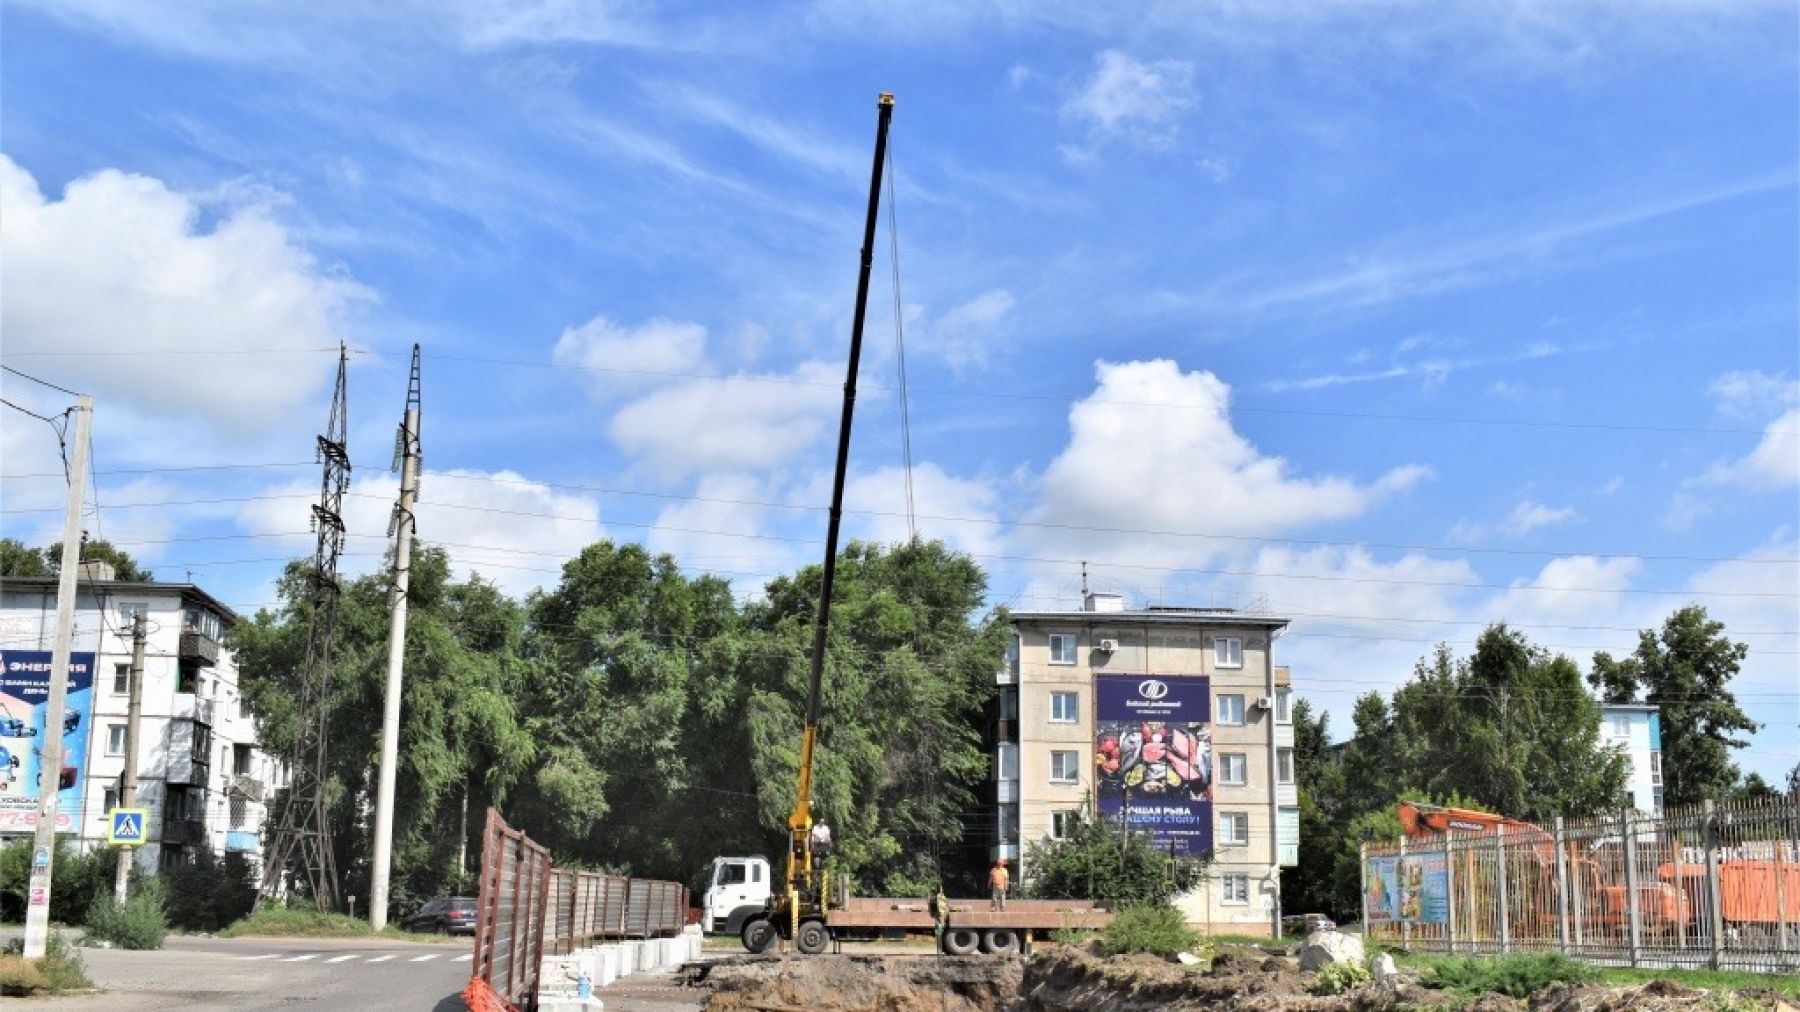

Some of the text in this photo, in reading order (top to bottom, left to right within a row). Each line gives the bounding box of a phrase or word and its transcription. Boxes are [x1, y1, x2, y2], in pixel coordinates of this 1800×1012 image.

[10, 662, 87, 673] ЭНЕРИЯ
[1163, 807, 1191, 815] РЫБА
[1164, 815, 1200, 823] СТОЛУ!
